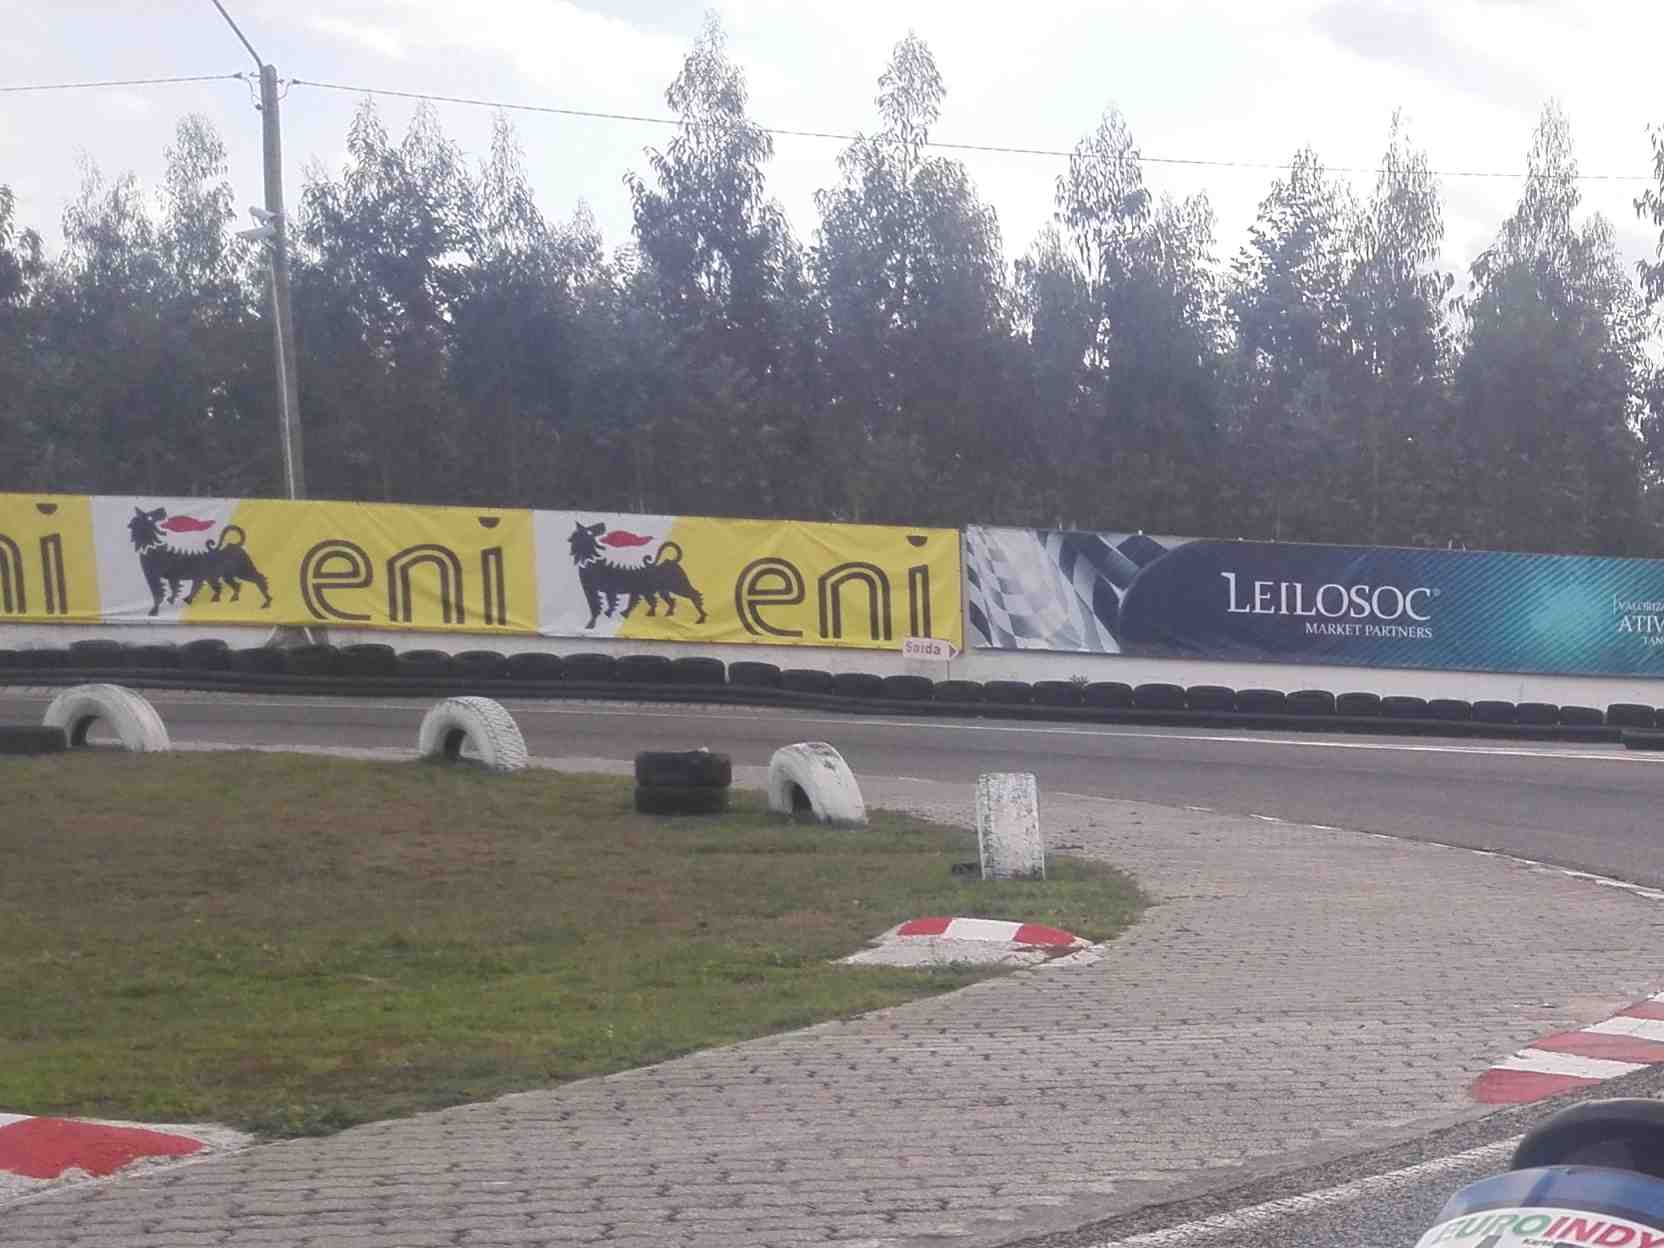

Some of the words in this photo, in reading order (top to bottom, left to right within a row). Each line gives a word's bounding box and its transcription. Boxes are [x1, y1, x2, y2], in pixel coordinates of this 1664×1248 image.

[300, 516, 507, 624] eni
[735, 535, 932, 641] eni
[1220, 572, 1432, 621] LEILOSOC
[1305, 621, 1362, 636] MARKET
[1365, 624, 1433, 639] PARTNERS
